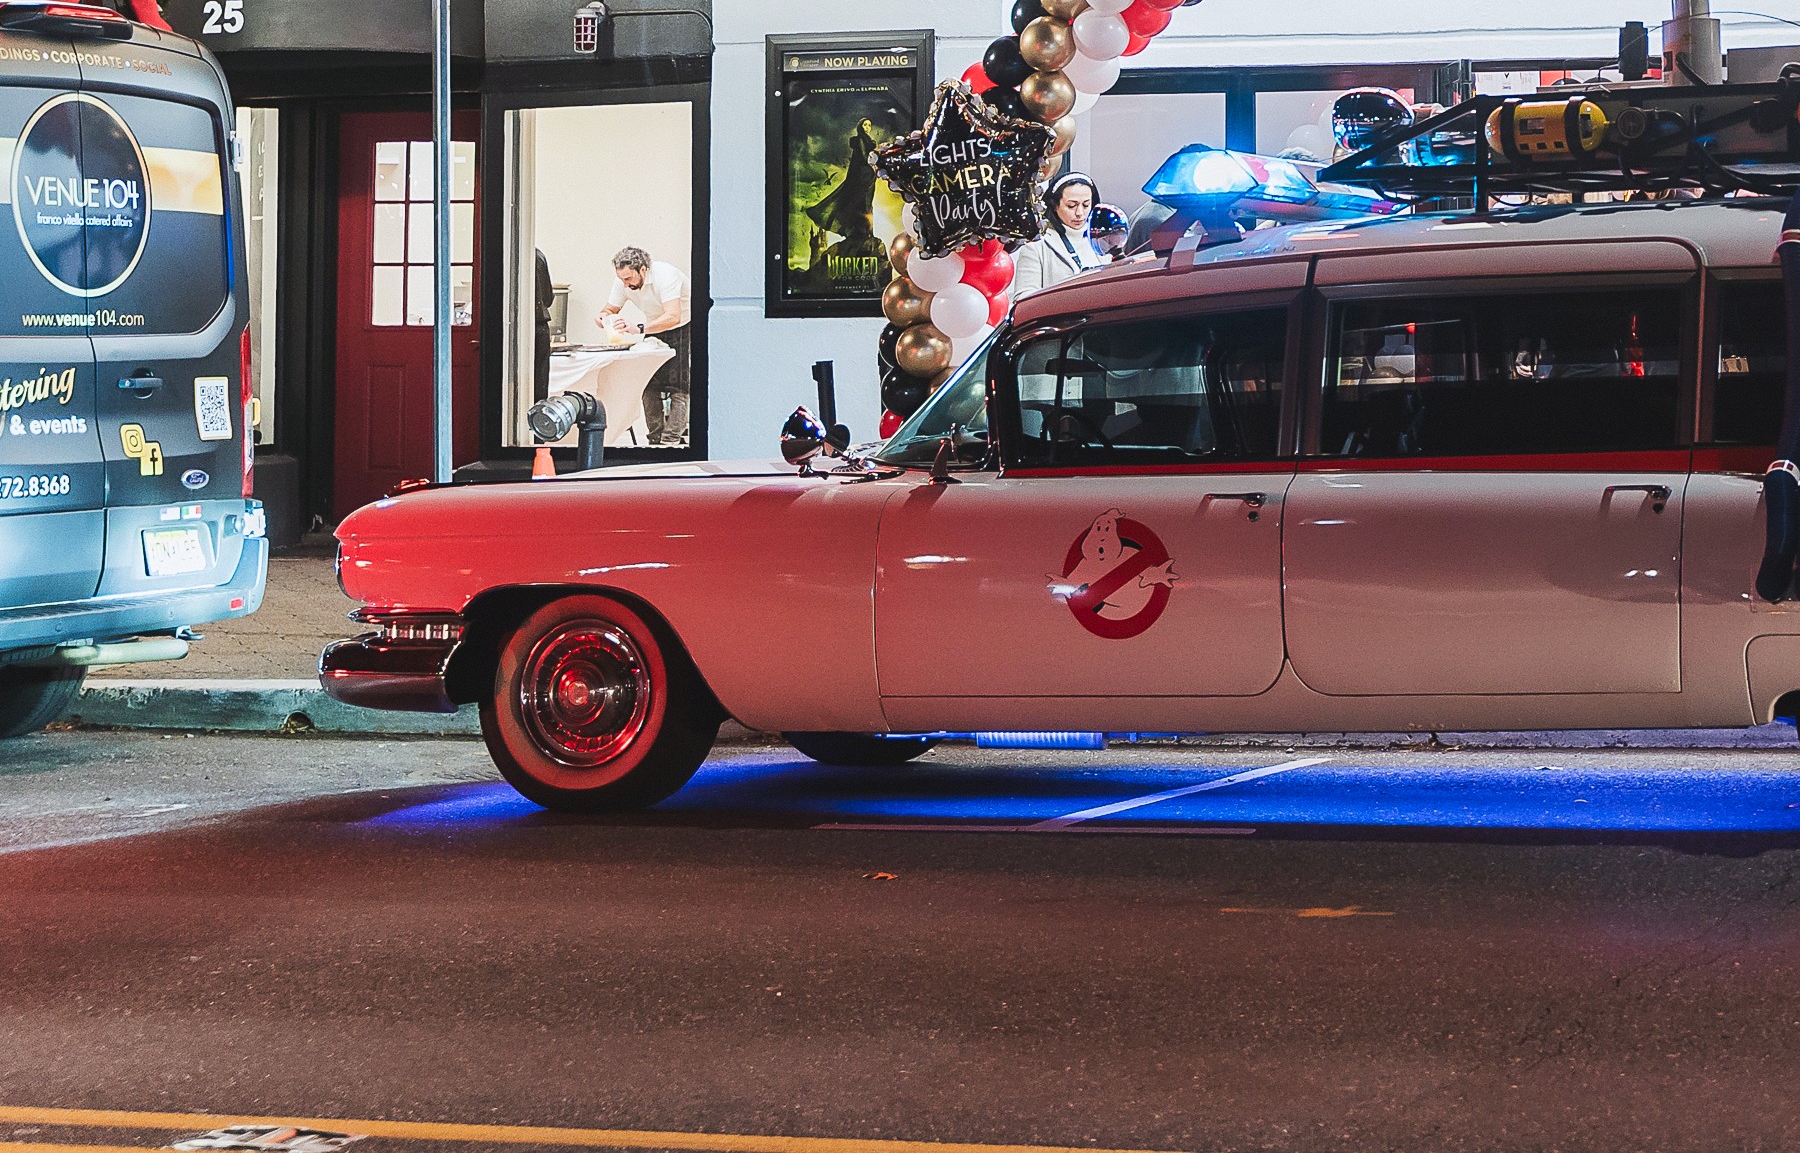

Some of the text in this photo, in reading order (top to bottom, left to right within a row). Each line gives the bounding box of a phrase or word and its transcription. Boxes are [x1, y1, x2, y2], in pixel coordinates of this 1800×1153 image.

[202, 0, 245, 35] 25
[51, 51, 124, 70] CORPORATE
[131, 59, 173, 76] SOCIAL
[824, 57, 854, 67] NOW
[858, 56, 909, 66] PLAYING
[24, 175, 140, 209] VENUE 104
[911, 164, 1012, 196] CAMERA
[37, 212, 62, 225] franco
[85, 214, 111, 226] catered
[112, 214, 133, 227] affairs
[827, 253, 878, 280] WICKED
[22, 310, 145, 327] www.venue104.com
[10, 414, 27, 436] &
[30, 415, 87, 434] events
[0, 474, 70, 498] 72.8368
